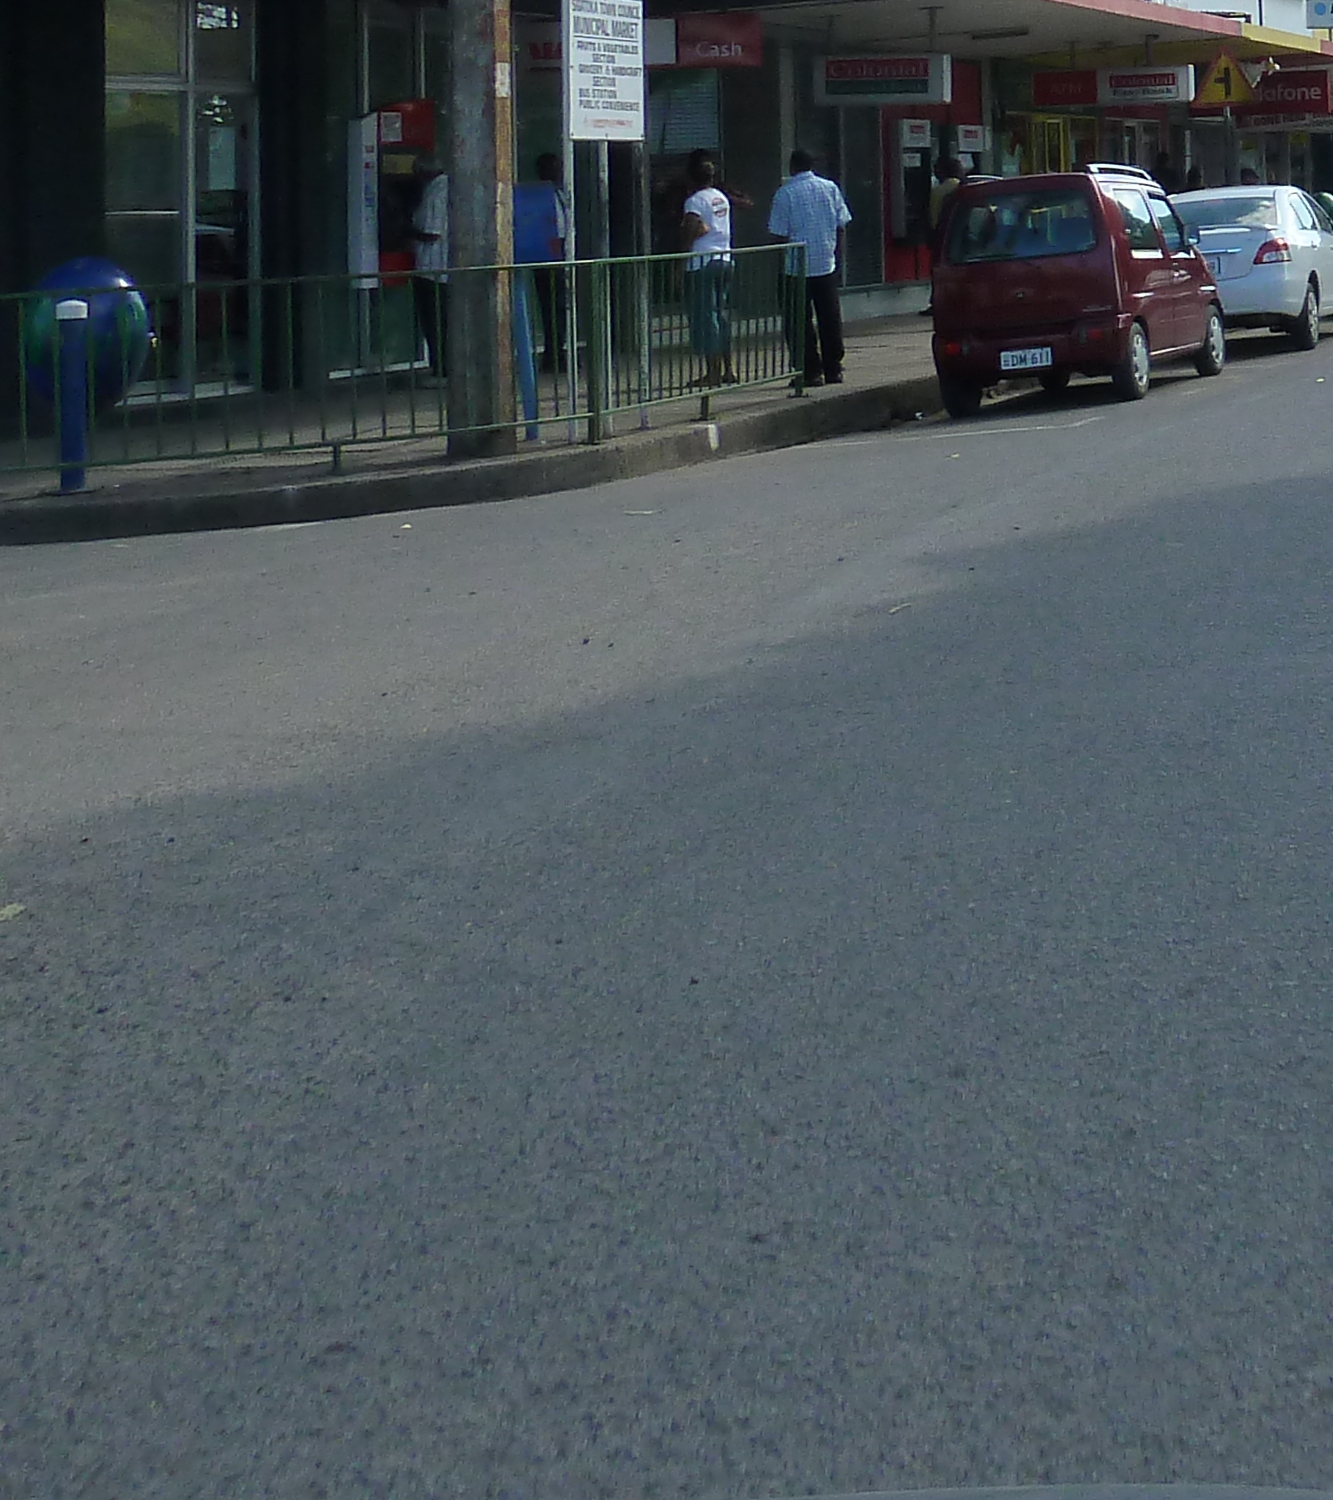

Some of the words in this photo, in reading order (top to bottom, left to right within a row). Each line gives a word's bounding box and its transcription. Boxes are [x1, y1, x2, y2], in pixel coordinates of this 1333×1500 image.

[573, 15, 610, 36] MUNICIPAL
[611, 20, 638, 39] MARKET
[695, 41, 742, 57] Cash
[830, 61, 927, 77] Colonial
[592, 76, 616, 87] SECTION
[578, 88, 590, 98] BUS
[592, 89, 617, 99] STATION
[1258, 82, 1323, 102] afone
[579, 99, 600, 109] PUBLIC
[602, 101, 640, 111] CONVENIENCE
